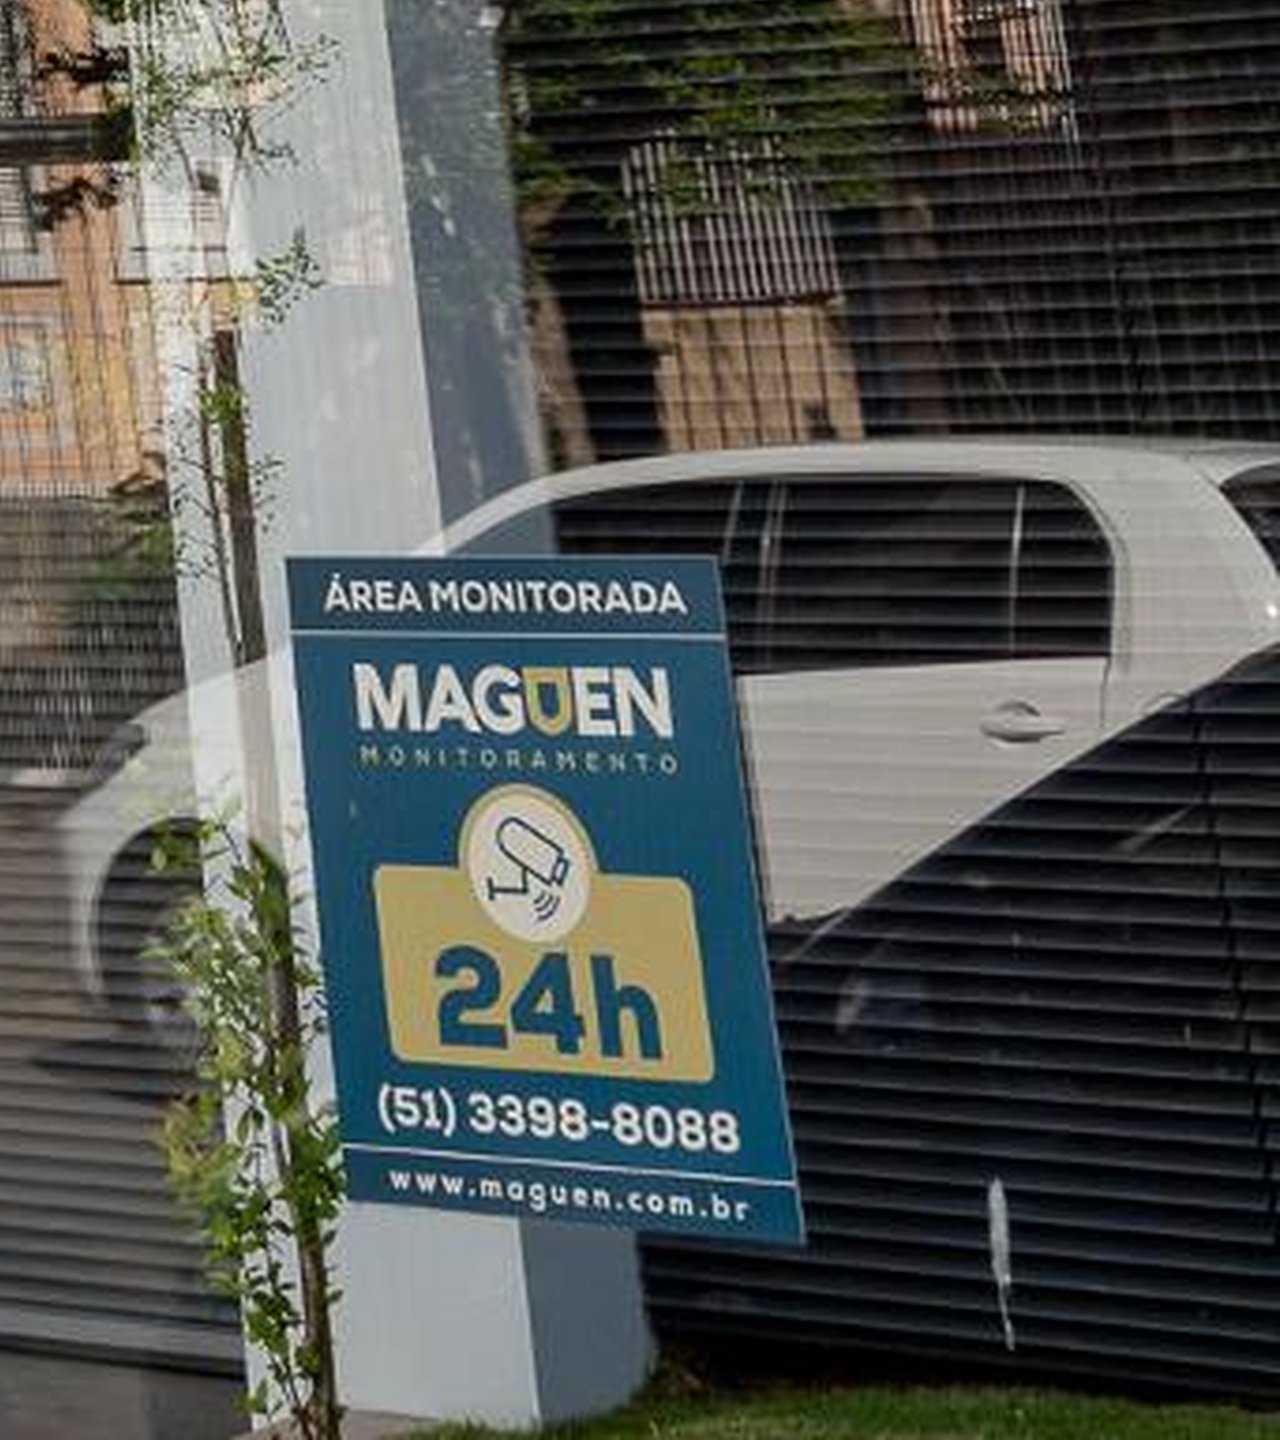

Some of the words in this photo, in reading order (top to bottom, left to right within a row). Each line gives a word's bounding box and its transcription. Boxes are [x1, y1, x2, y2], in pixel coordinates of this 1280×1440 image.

[324, 573, 423, 613] ÁREA
[430, 580, 688, 615] MONITORADA
[352, 662, 675, 739] MAGUEN
[360, 744, 679, 775] MONITORAMENTO
[435, 944, 665, 1061] 24h
[377, 1082, 456, 1138] (51)
[467, 1091, 741, 1154] 3398-8088
[387, 1169, 751, 1222] www.maguen.com.br
